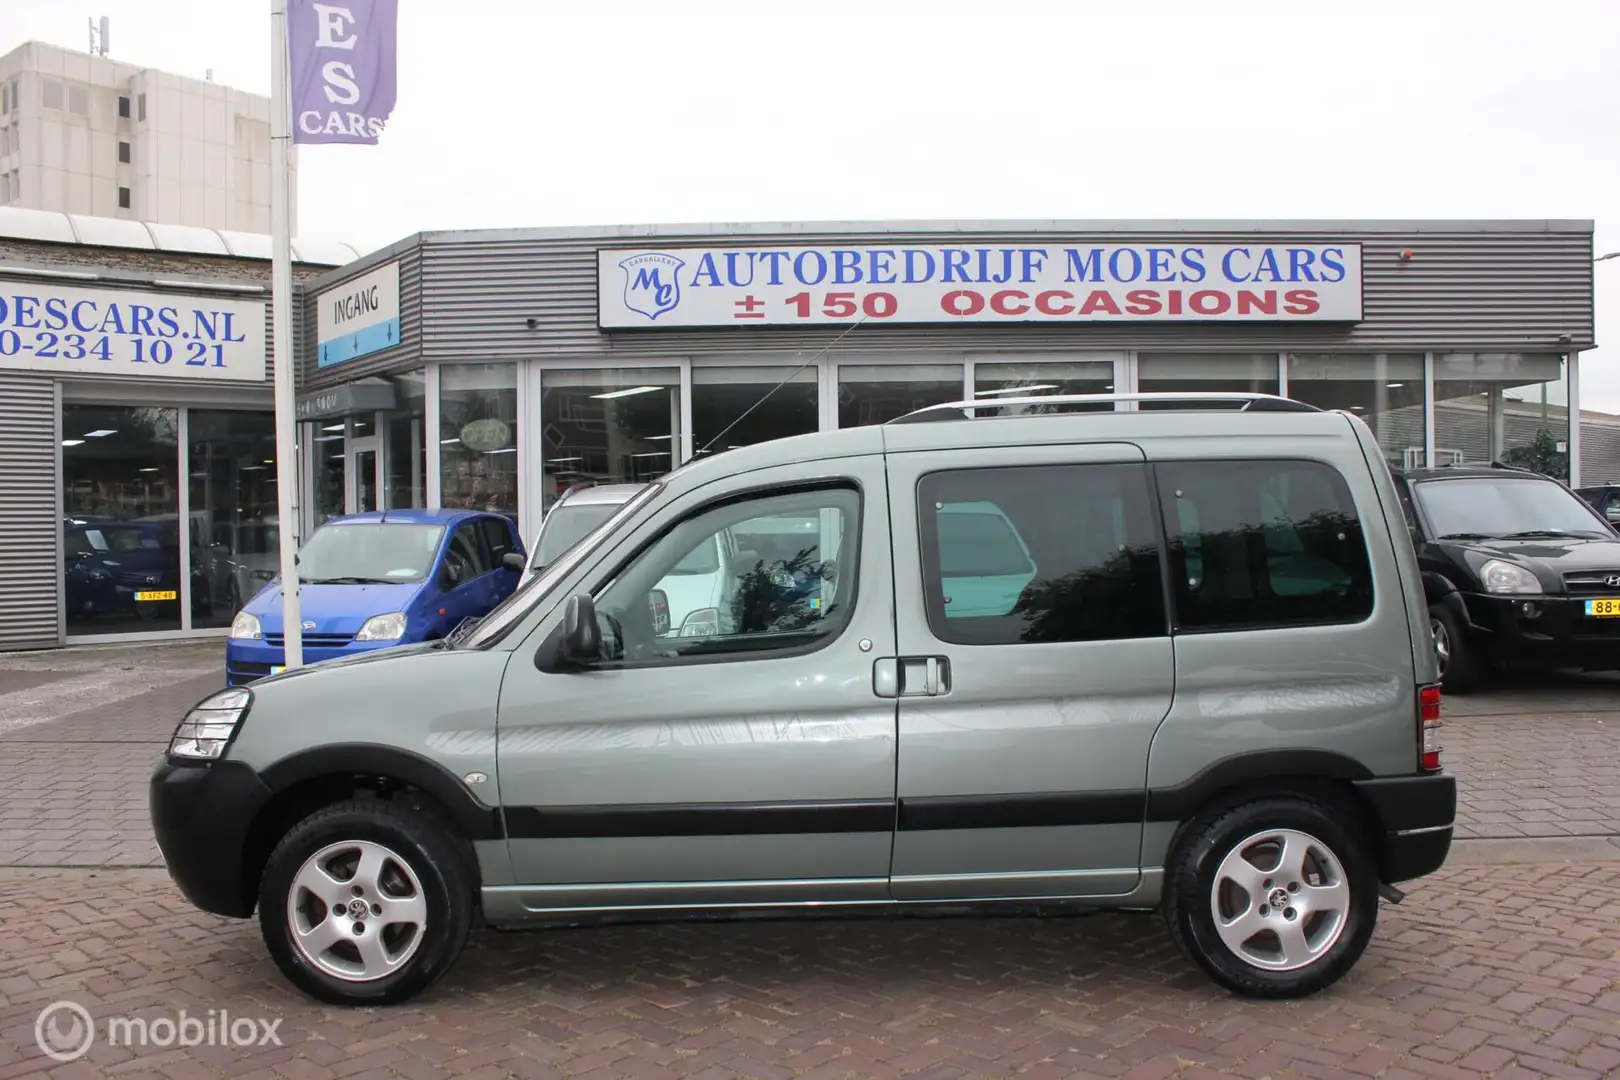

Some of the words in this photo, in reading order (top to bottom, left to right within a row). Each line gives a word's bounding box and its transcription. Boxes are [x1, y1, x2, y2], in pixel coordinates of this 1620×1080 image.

[299, 110, 386, 139] CARS
[690, 247, 1049, 287] AUTOBEDRIJF
[1064, 247, 1207, 283] MOES
[1221, 247, 1346, 284] CARS
[334, 284, 378, 325] INGANG
[784, 292, 898, 318] 150
[940, 289, 1321, 316] OCCASIONS
[0, 329, 114, 361] 0-234
[130, 338, 173, 364] 10
[185, 342, 228, 368] 21
[1596, 601, 1620, 613] 88-
